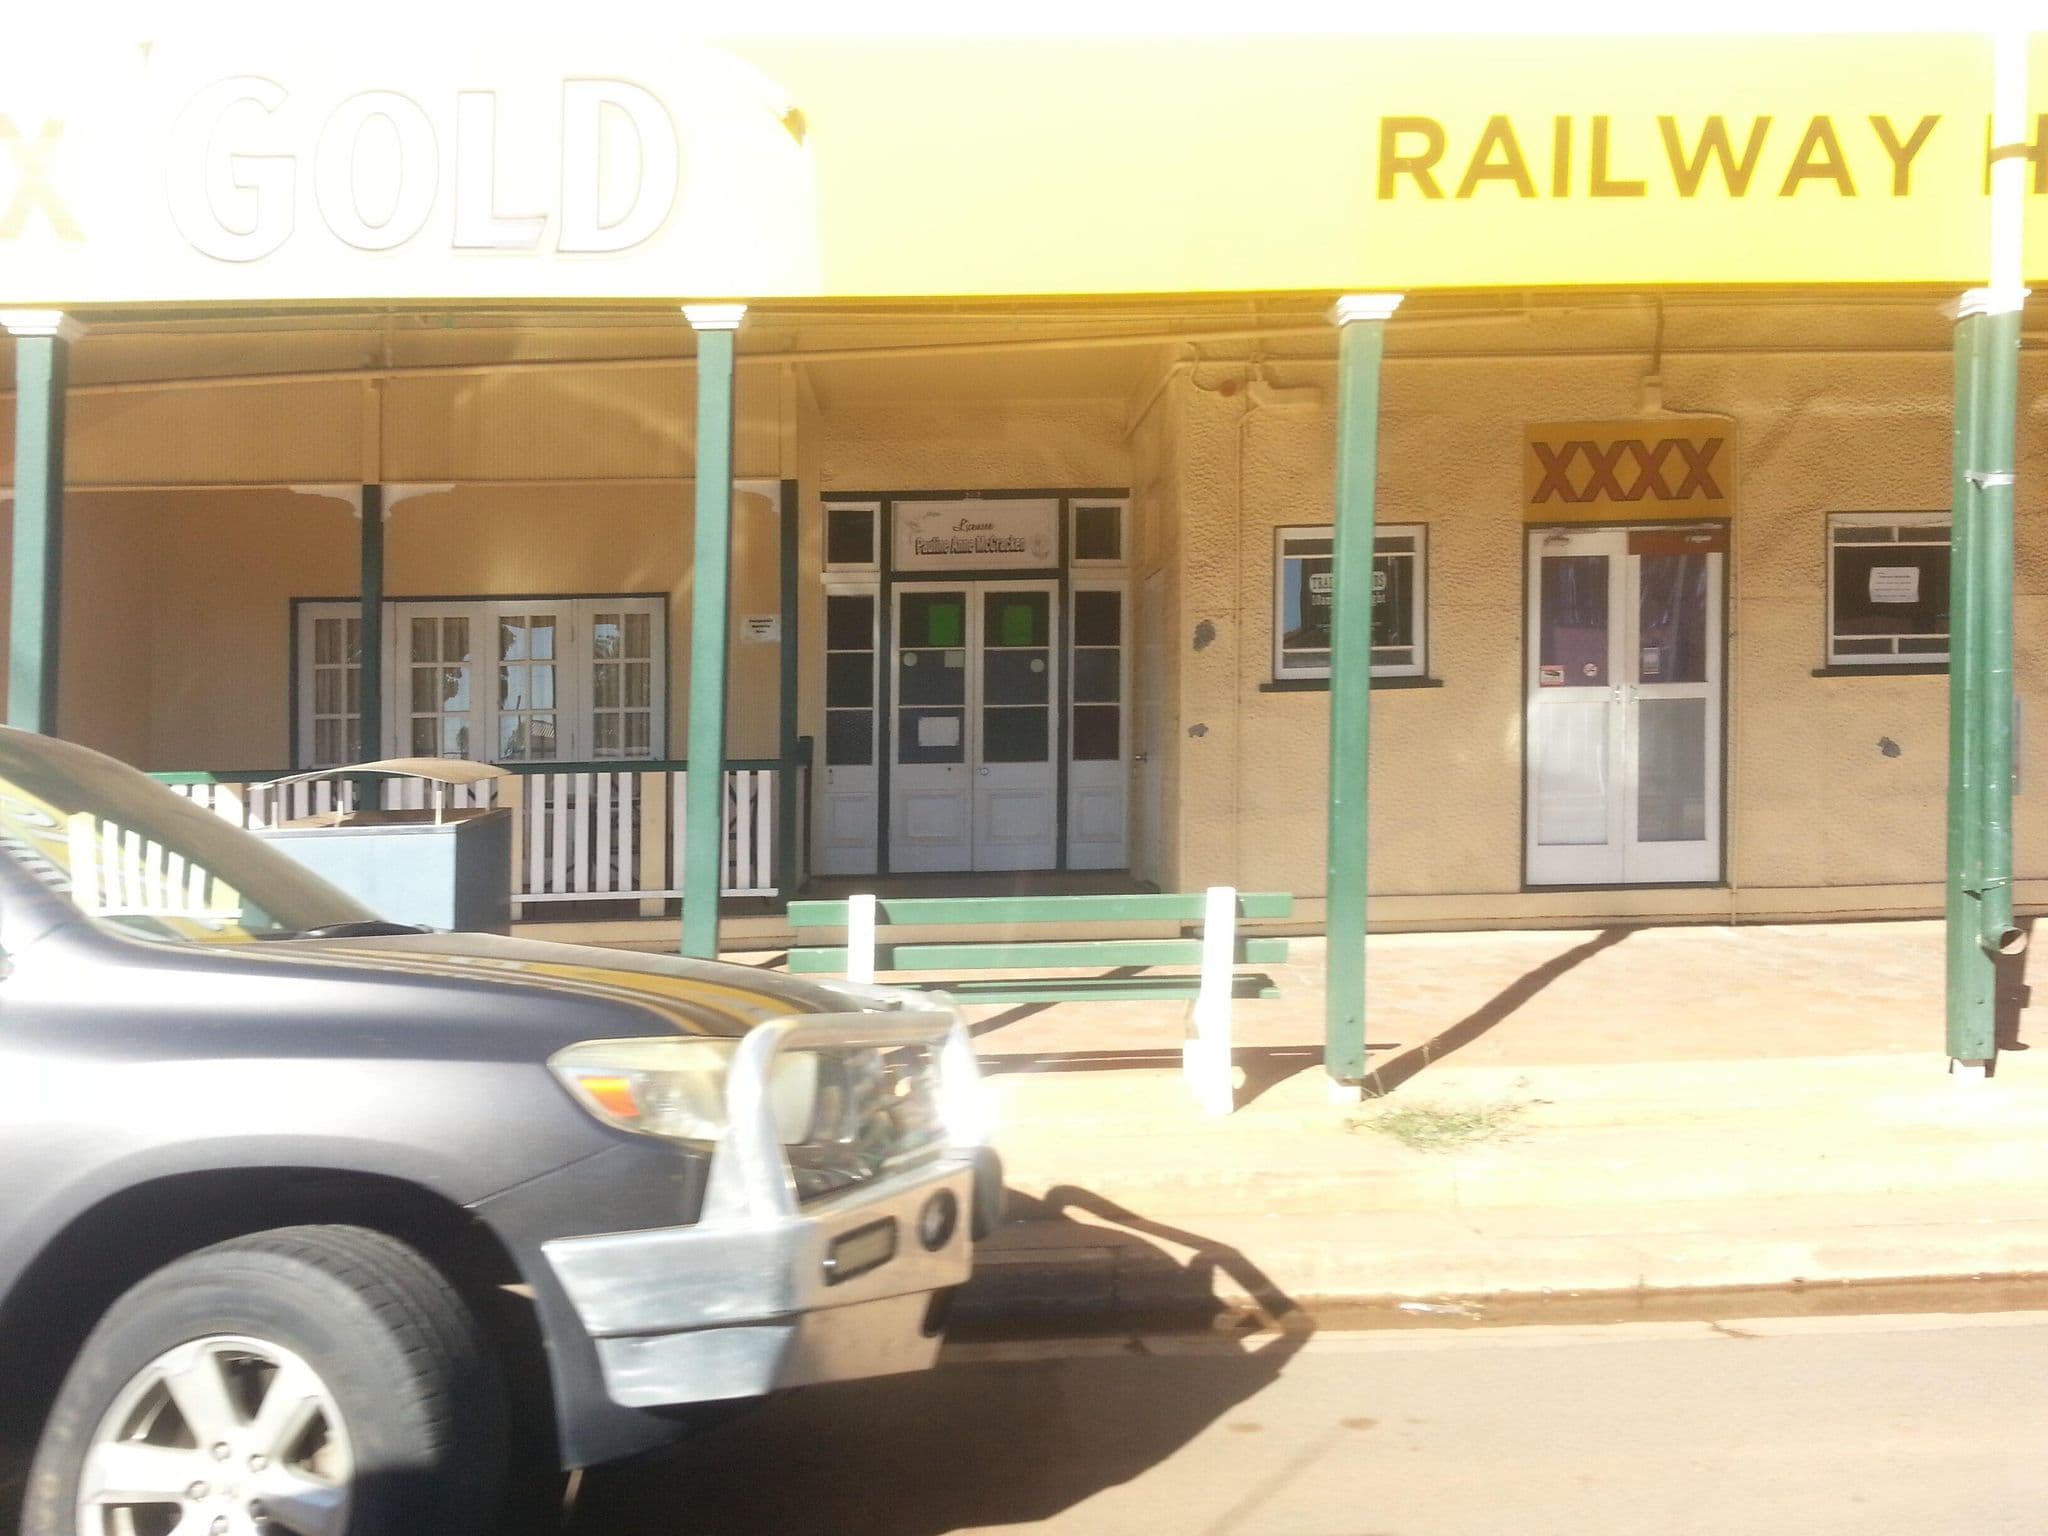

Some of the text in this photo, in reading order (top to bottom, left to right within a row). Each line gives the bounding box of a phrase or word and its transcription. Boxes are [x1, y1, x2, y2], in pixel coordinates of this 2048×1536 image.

[165, 74, 681, 264] GOLD
[1377, 114, 1942, 200] RAILWAY
[1530, 437, 1725, 504] XXXX
